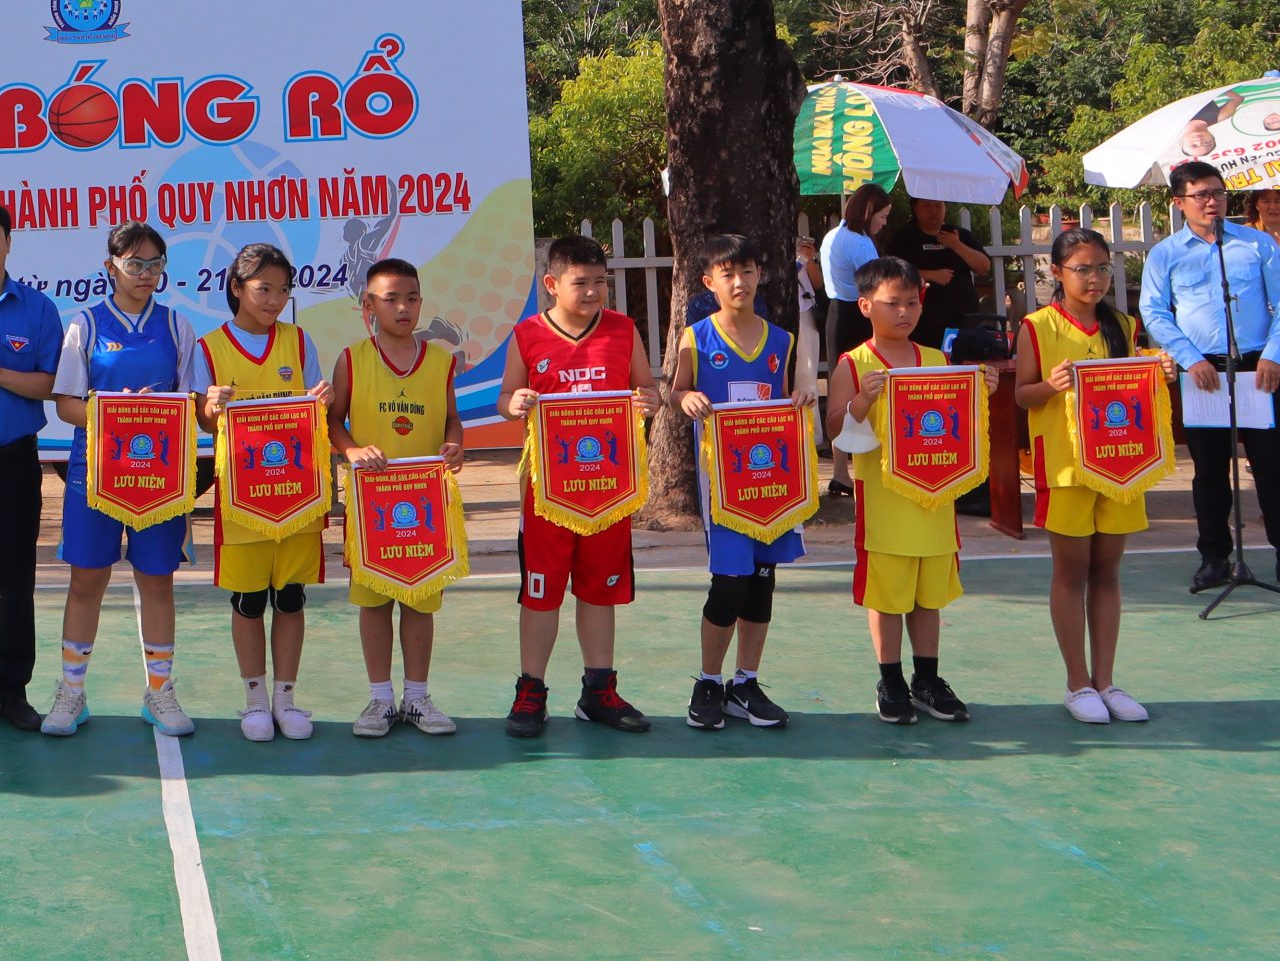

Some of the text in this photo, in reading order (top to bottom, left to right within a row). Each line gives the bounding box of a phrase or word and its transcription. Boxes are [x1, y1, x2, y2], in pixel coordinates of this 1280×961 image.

[284, 34, 418, 142] RỔ
[812, 139, 832, 175] MUA
[833, 120, 873, 194] HÔNG
[88, 170, 149, 227] PHỐ
[157, 181, 215, 229] QUY
[225, 175, 309, 222] NHƠN
[319, 168, 388, 216] NĂM
[399, 172, 471, 214] 2024
[380, 403, 386, 412] FC
[908, 449, 957, 467] LƯU NIỆM
[1096, 441, 1144, 458] LƯU NIỆM
[114, 474, 165, 491] LƯU NIỆM
[563, 475, 617, 493] LƯU NIỆM
[752, 471, 771, 479] 2024
[250, 480, 302, 497] LƯU NIỆM
[738, 482, 787, 501] LƯU NIỆM
[380, 542, 434, 559] LƯU NIỆM
